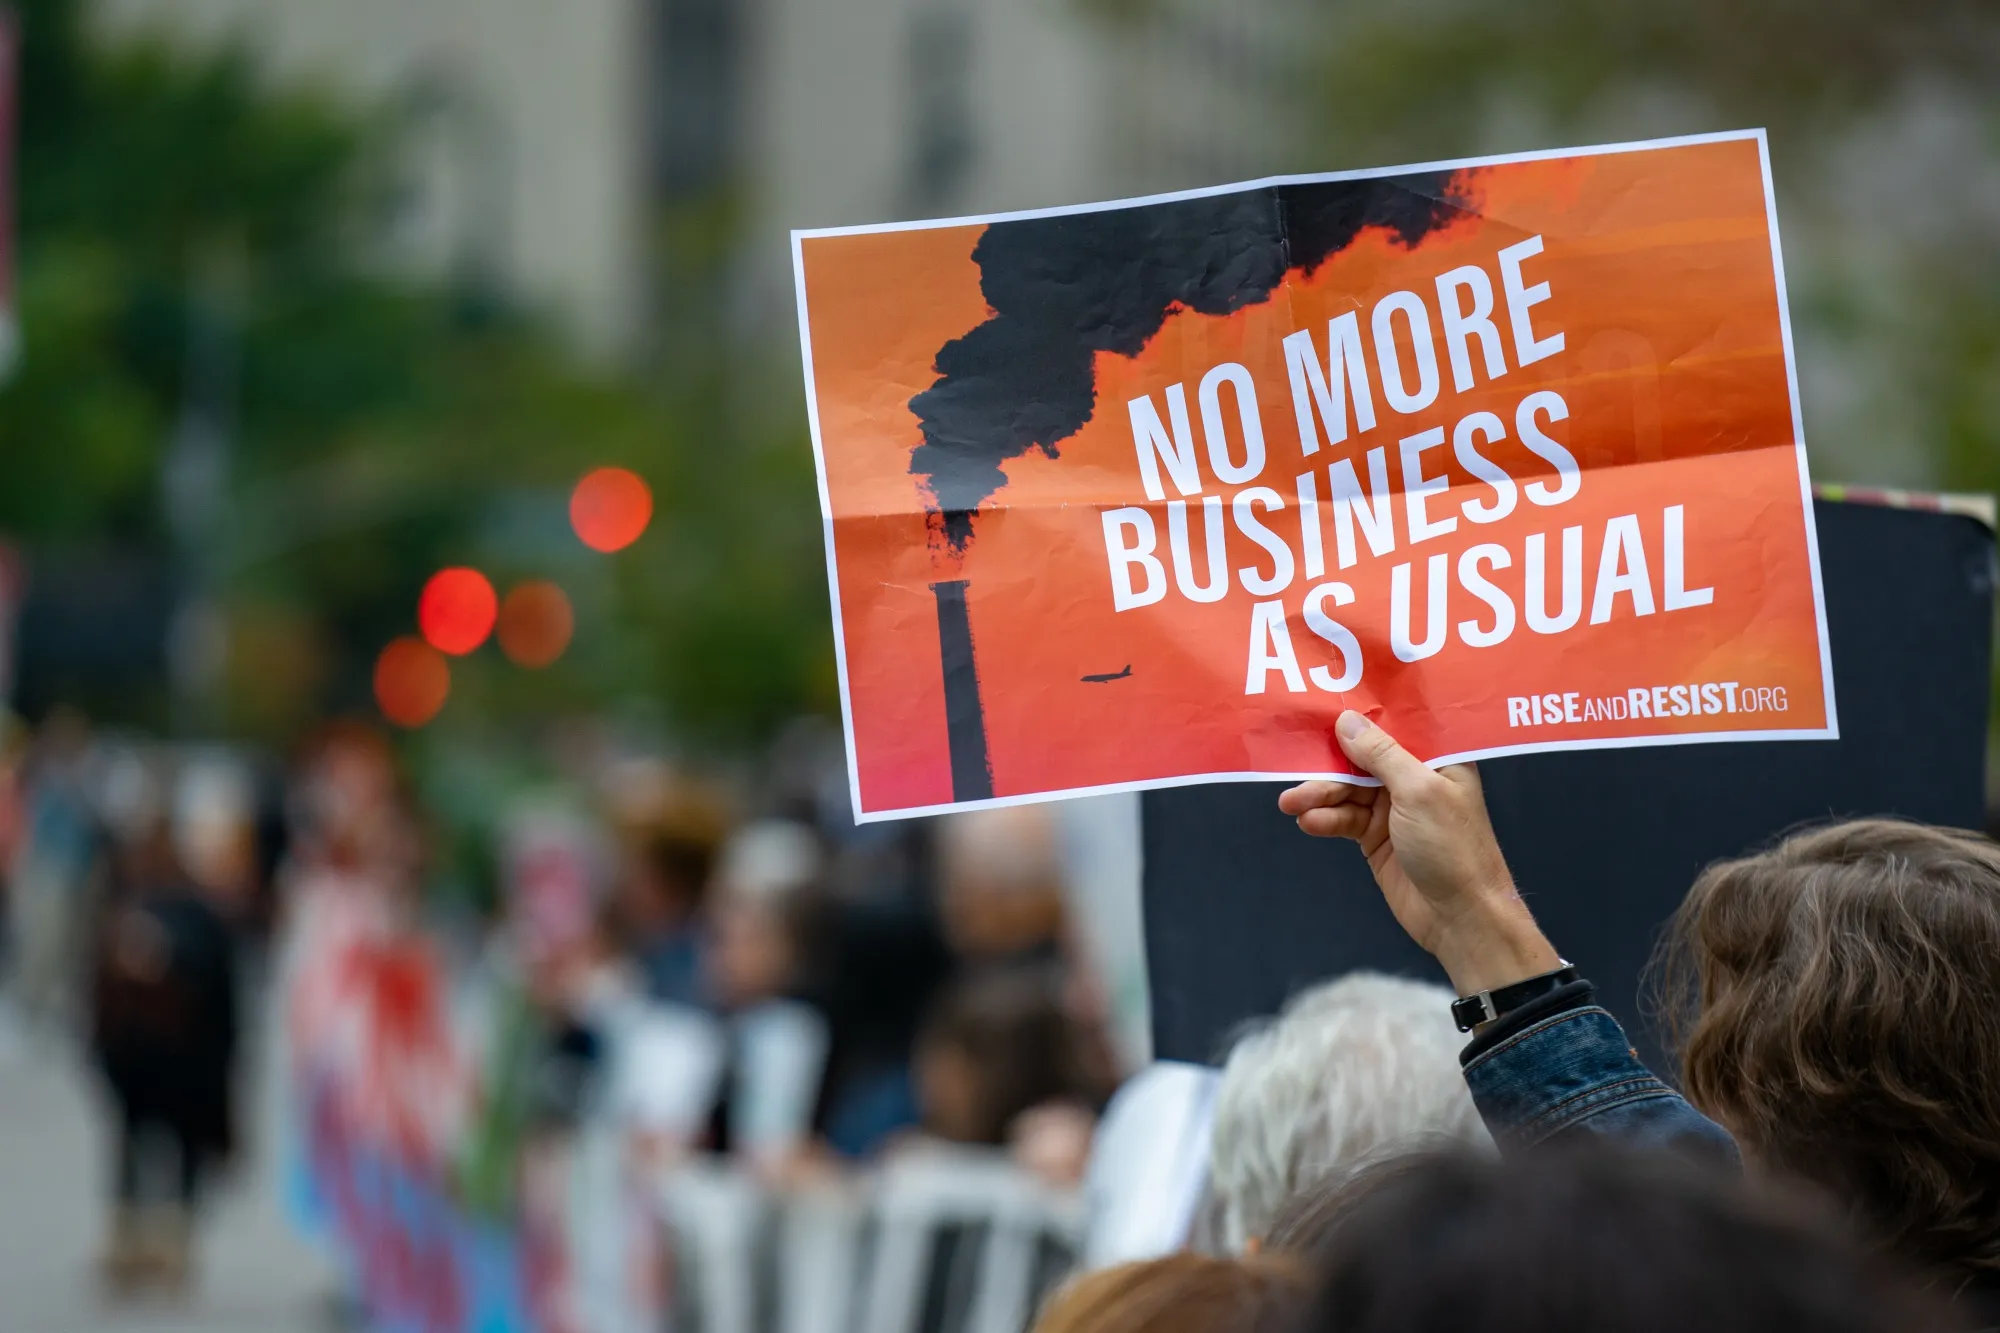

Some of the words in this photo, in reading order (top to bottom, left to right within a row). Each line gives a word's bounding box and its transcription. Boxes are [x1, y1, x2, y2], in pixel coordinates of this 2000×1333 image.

[1127, 362, 1266, 501] NO
[1282, 234, 1565, 457] MORE
[1101, 390, 1582, 613] BUSINESS
[1244, 581, 1363, 695] AS
[1390, 504, 1714, 663] USUAL
[1507, 682, 1788, 727] RISEANDRESIST.ORG
